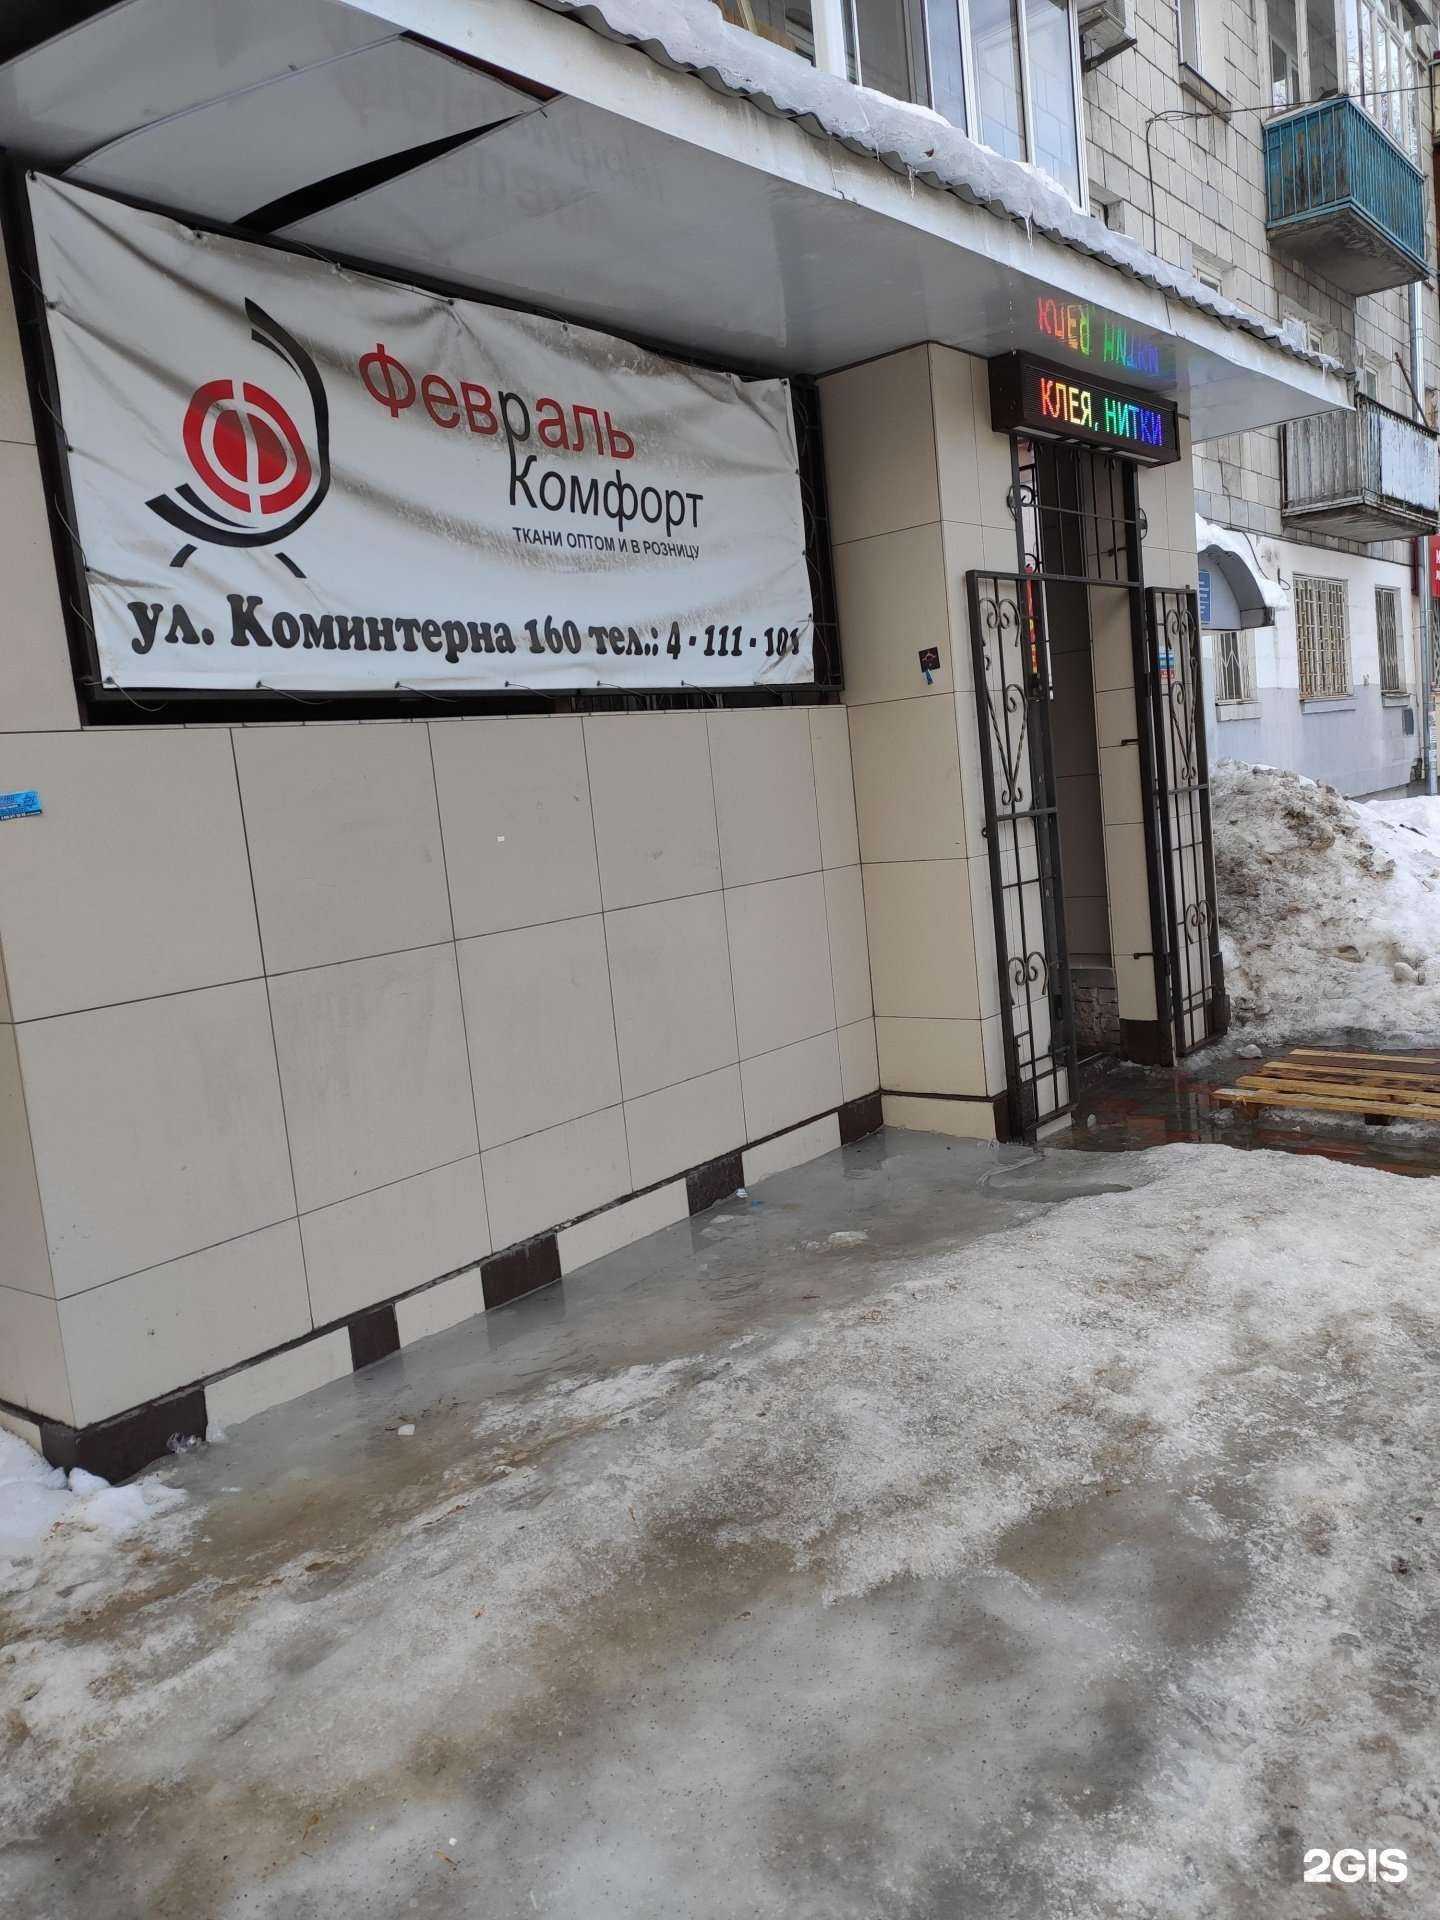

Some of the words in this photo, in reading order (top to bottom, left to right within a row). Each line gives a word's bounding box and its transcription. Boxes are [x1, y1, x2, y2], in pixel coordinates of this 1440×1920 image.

[358, 343, 636, 460] Февраль
[1040, 377, 1100, 433] КЛЕЯ,
[1105, 398, 1163, 447] НИТКИ
[509, 453, 704, 537] Комфорт
[512, 526, 563, 547] ТКАНИ
[566, 532, 616, 552] ОПТОМ
[618, 538, 628, 553] И
[631, 539, 641, 554] В
[643, 540, 700, 561] РОЗНИЦУ
[127, 601, 215, 654] ул.
[226, 593, 517, 664] Коминтерна
[524, 615, 582, 654] 160
